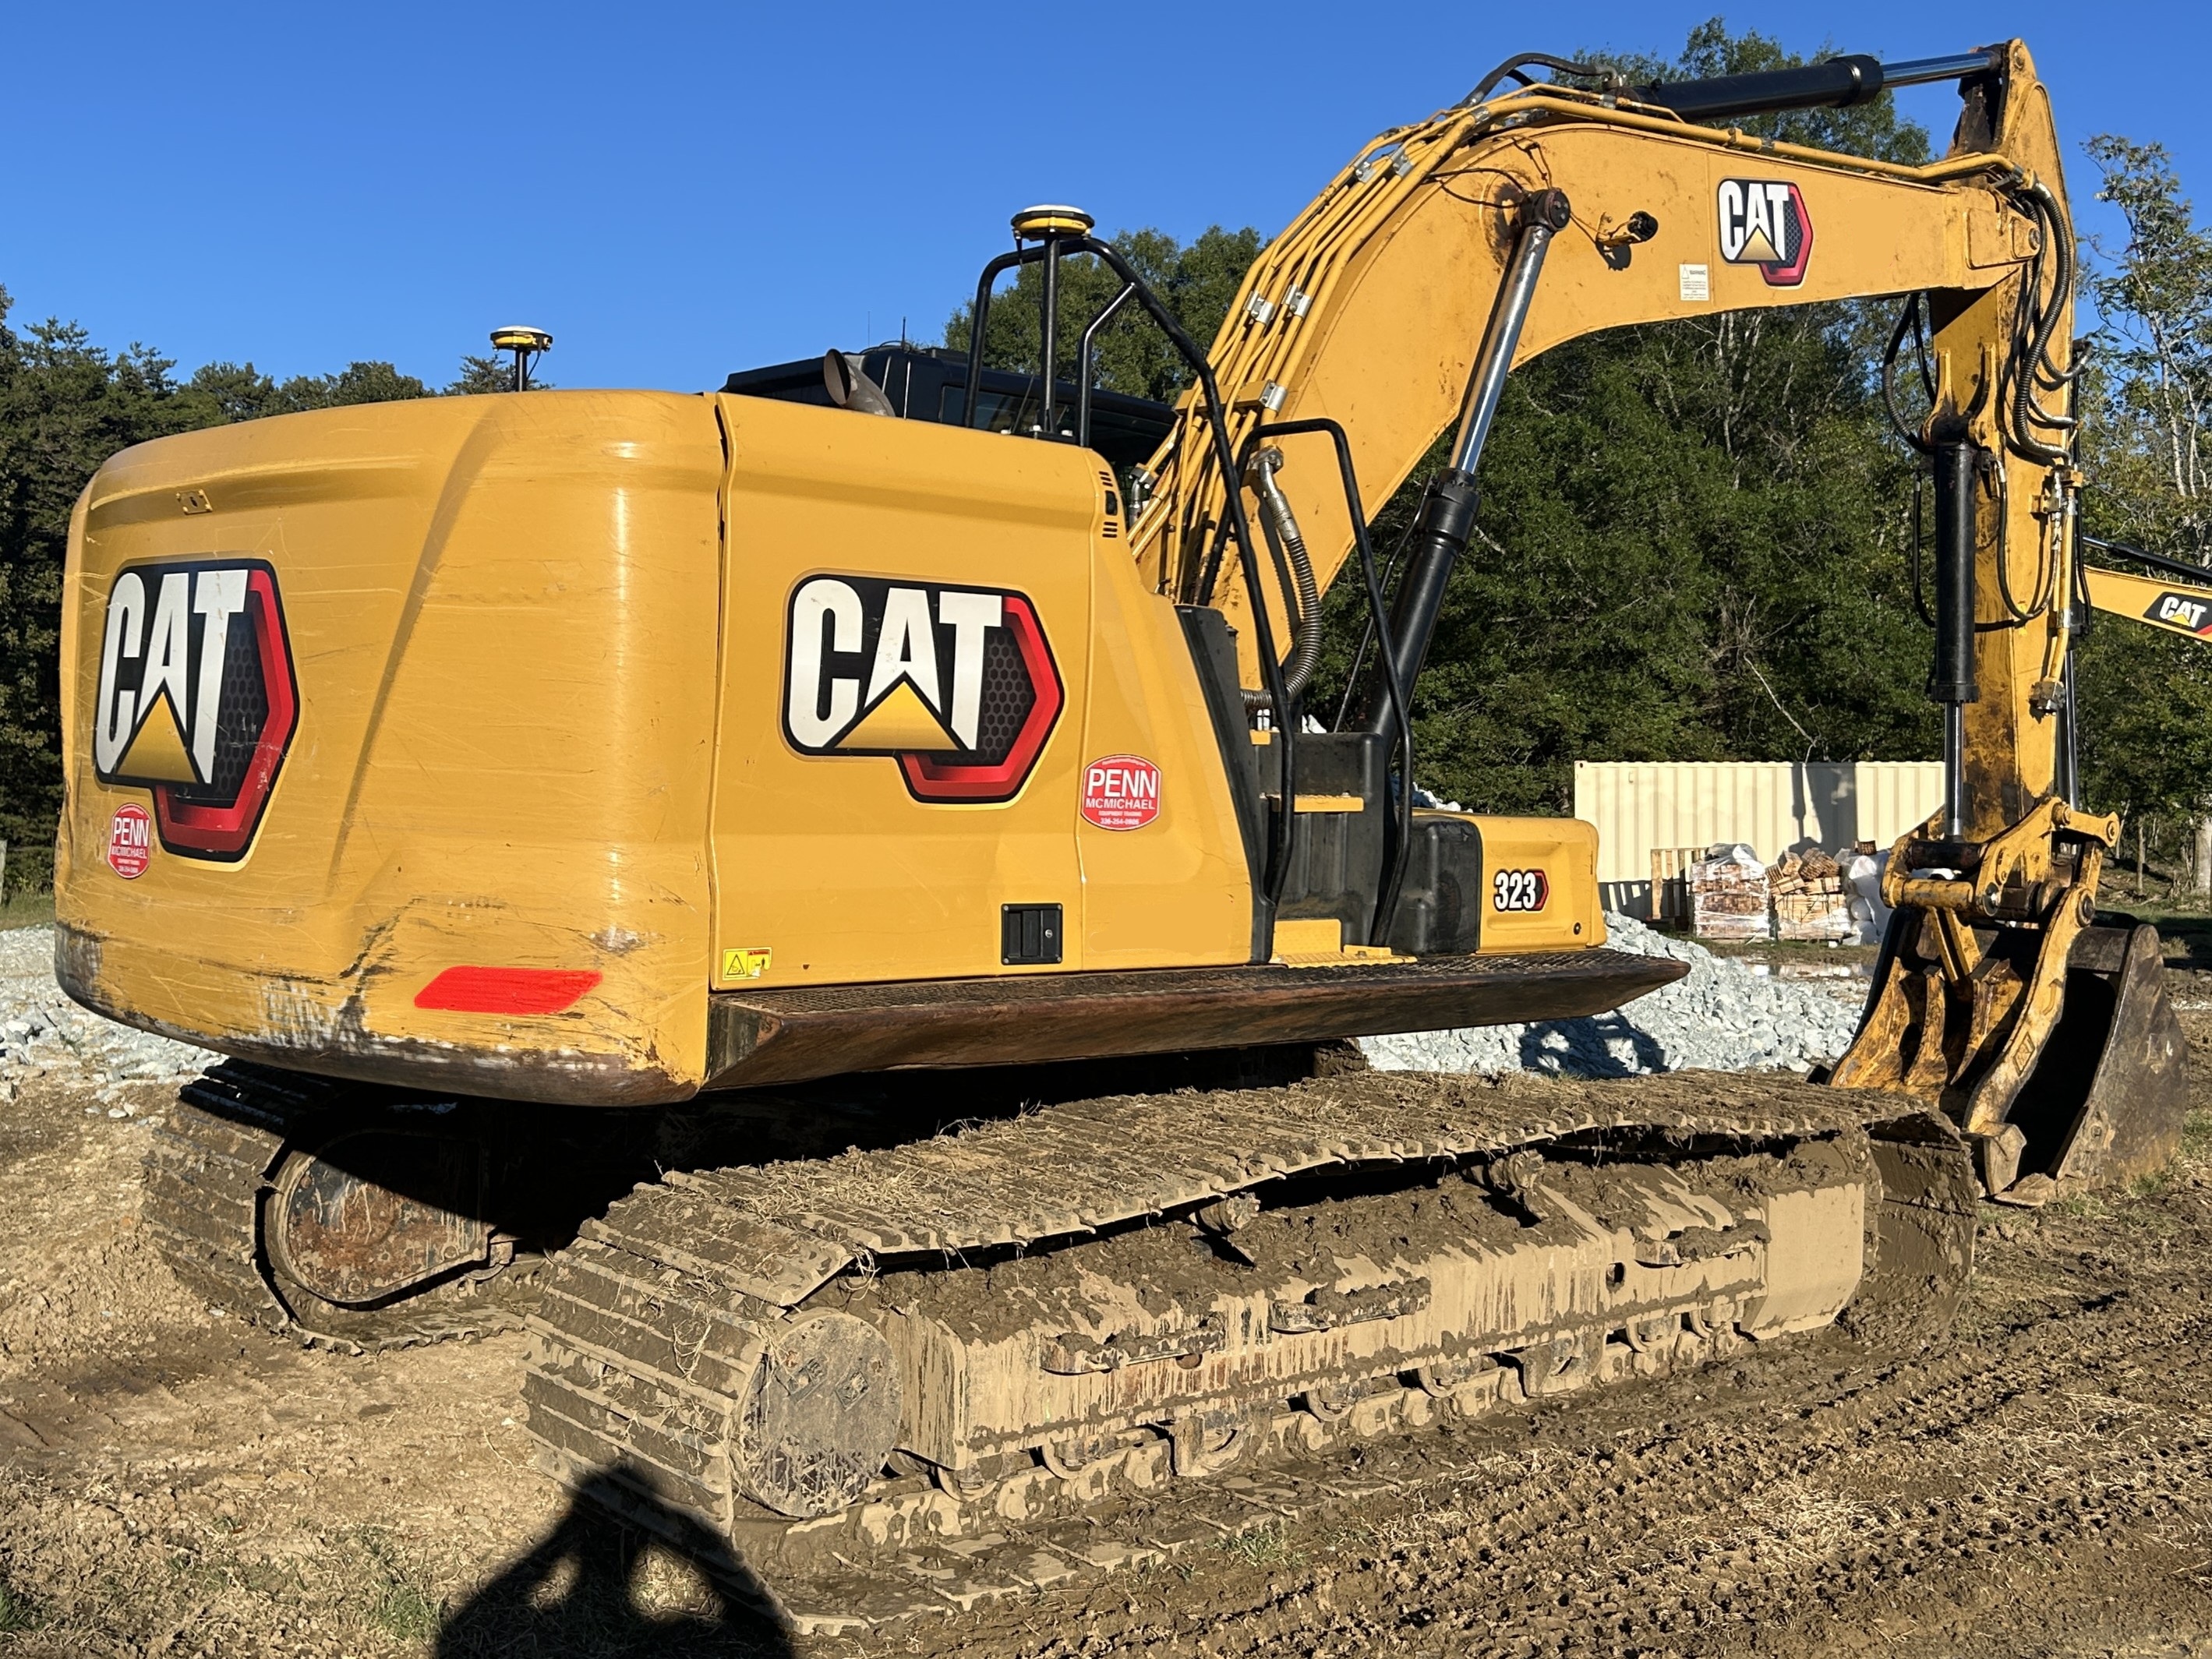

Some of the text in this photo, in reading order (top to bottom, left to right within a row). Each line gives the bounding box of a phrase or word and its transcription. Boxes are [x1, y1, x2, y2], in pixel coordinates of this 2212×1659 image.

[1719, 180, 1789, 261] CAT
[2160, 596, 2207, 628] CAT
[95, 570, 249, 784] CAT
[789, 579, 1002, 751] CAT
[1087, 768, 1157, 799] PENN
[1086, 798, 1156, 810] MCMICHAEL
[112, 817, 150, 847] PENN
[1495, 872, 1536, 909] 323
